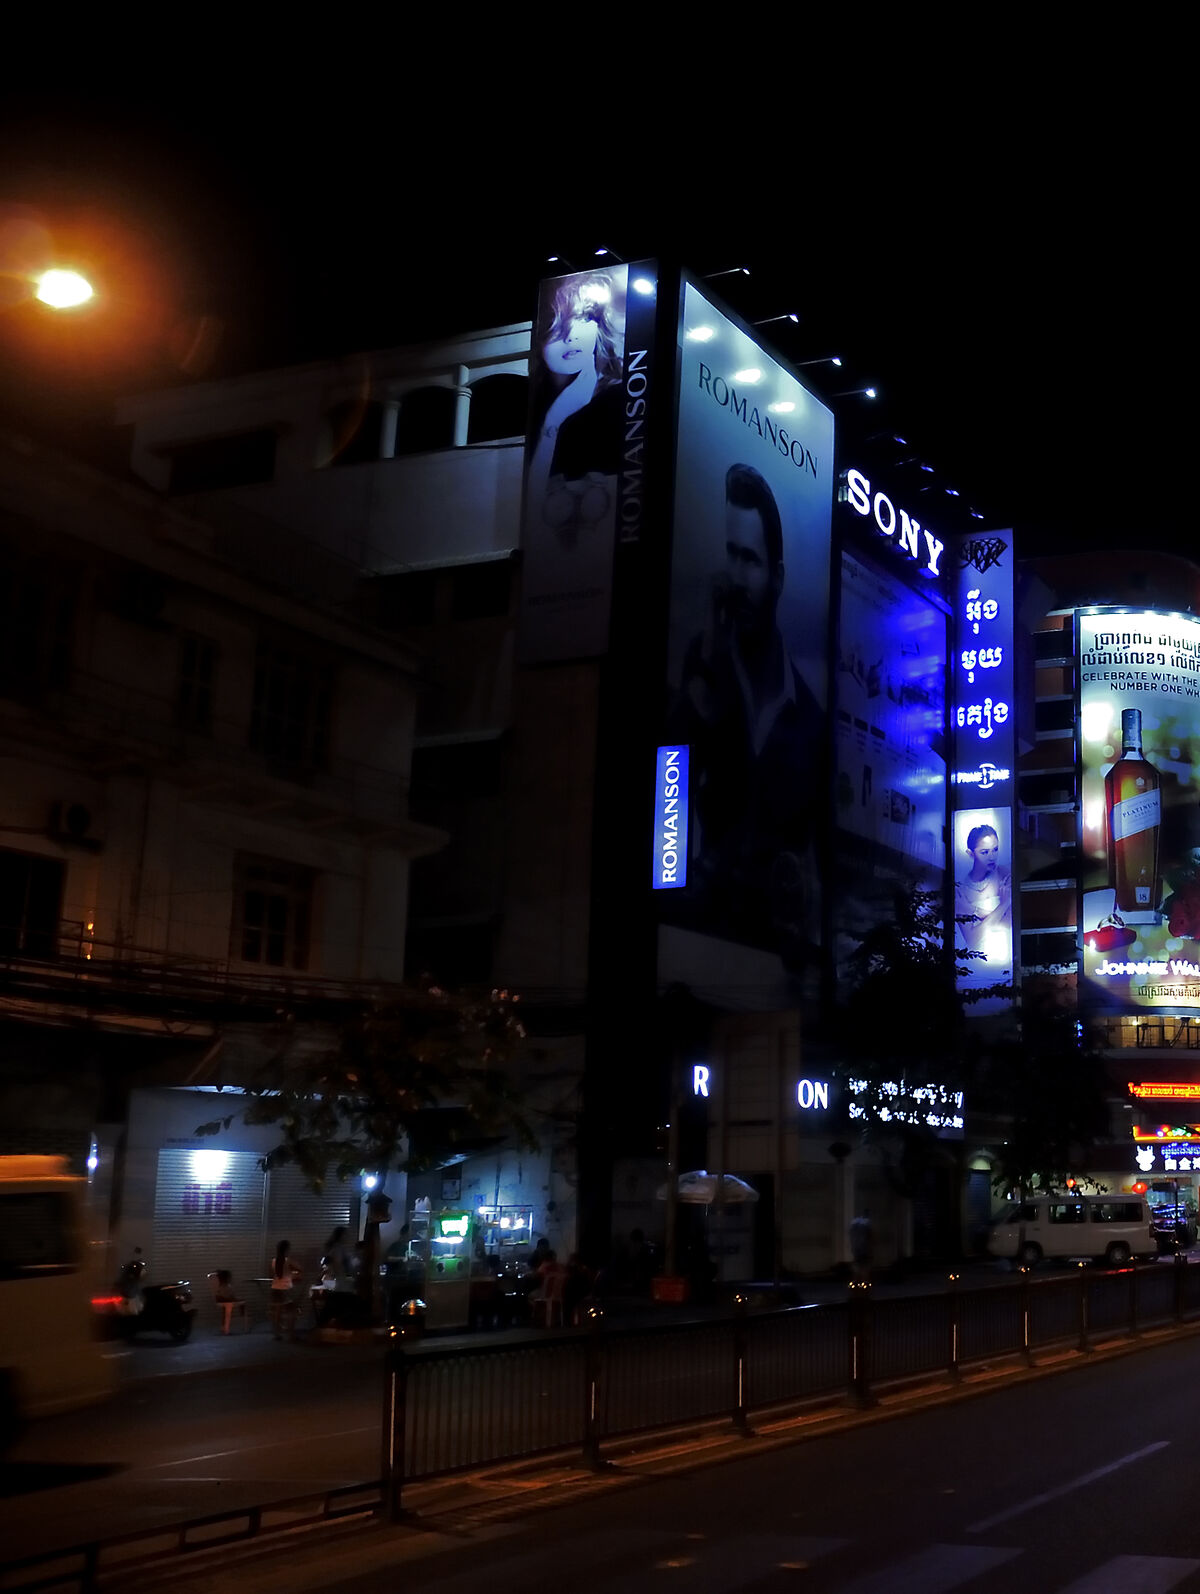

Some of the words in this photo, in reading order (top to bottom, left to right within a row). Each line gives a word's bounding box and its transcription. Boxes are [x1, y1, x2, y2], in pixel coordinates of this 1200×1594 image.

[620, 350, 648, 543] ROMANSON
[698, 361, 818, 479] ROMANSON
[847, 469, 944, 576] SONY
[1082, 671, 1147, 682] CELEBRATE
[1151, 672, 1179, 683] WITH
[1181, 676, 1198, 687] THE
[1110, 682, 1157, 691] NUMBER
[1161, 683, 1182, 694] ONE
[662, 751, 680, 883] ROMANSON
[1122, 801, 1158, 818] PLATINUM
[1095, 960, 1168, 976] JOHNNIE
